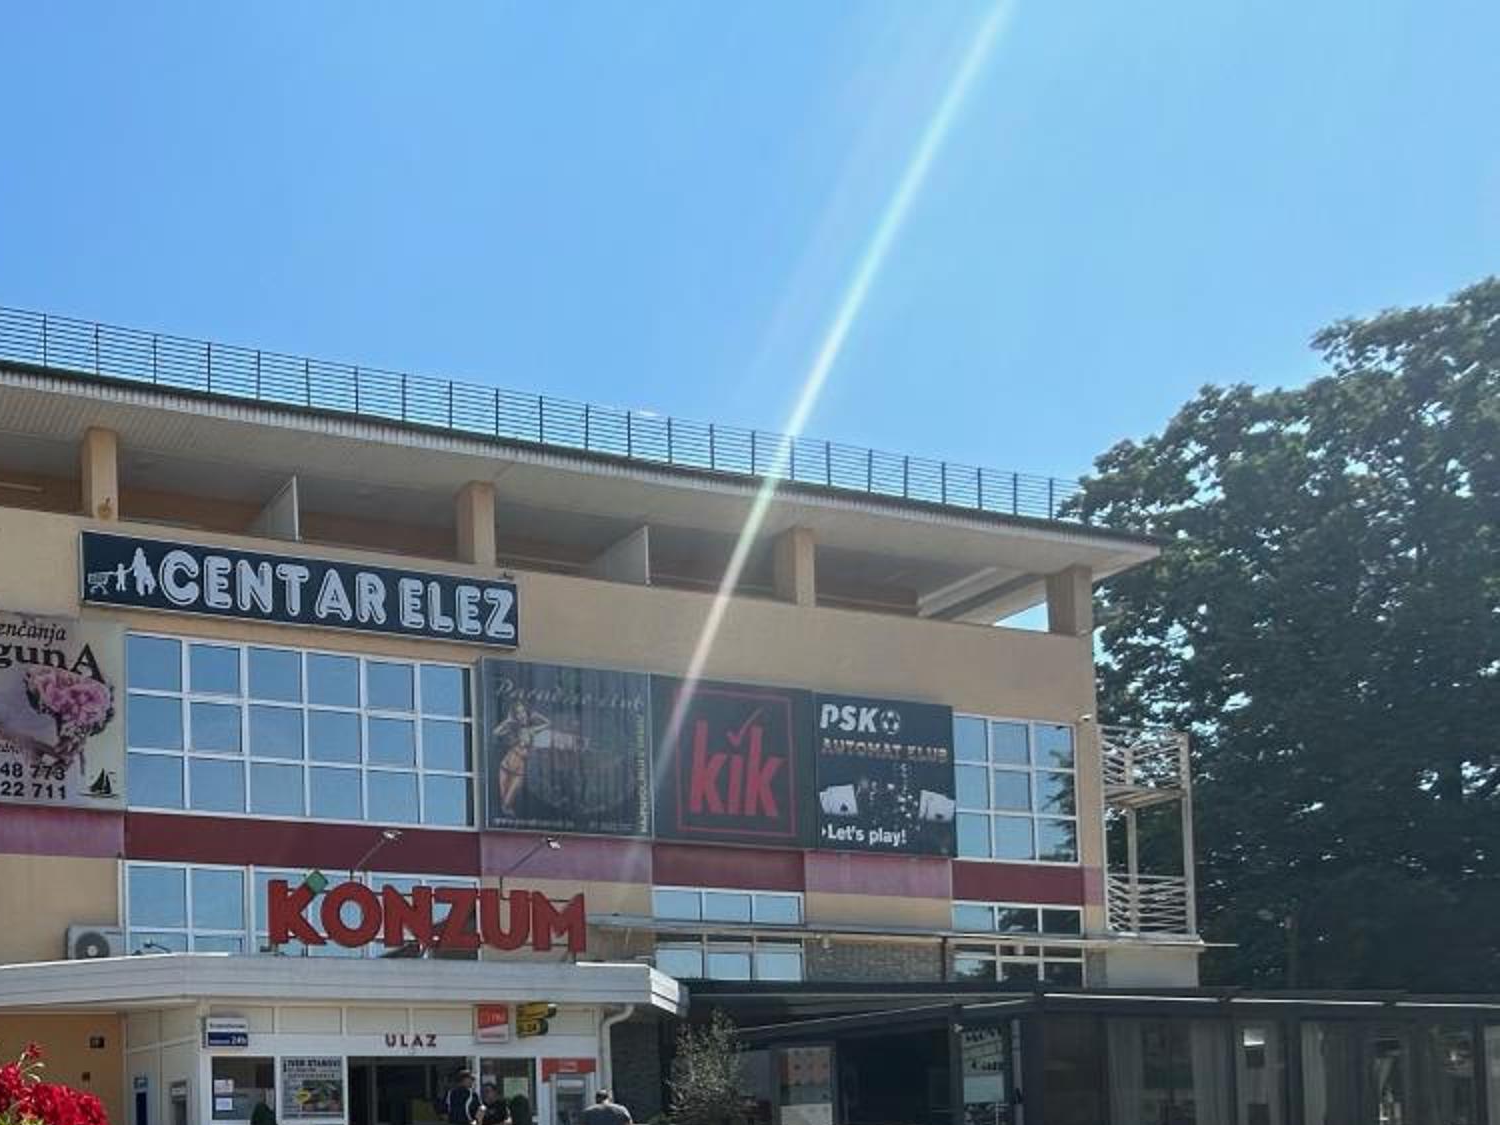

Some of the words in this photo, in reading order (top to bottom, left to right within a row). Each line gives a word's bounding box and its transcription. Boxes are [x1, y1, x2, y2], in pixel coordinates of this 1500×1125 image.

[159, 549, 387, 625] CENTAR
[398, 576, 516, 640] ELEZ
[820, 703, 879, 733] PSK
[820, 737, 902, 760] AUTOMAT
[907, 745, 948, 764] KLUB
[0, 763, 23, 779] 48
[31, 765, 67, 782] 773
[0, 781, 25, 797] 22
[32, 784, 67, 800] 711
[828, 823, 865, 842] Let's
[869, 826, 907, 848] play!
[267, 873, 587, 954] KONZUM
[385, 1033, 437, 1049] ULAZ
